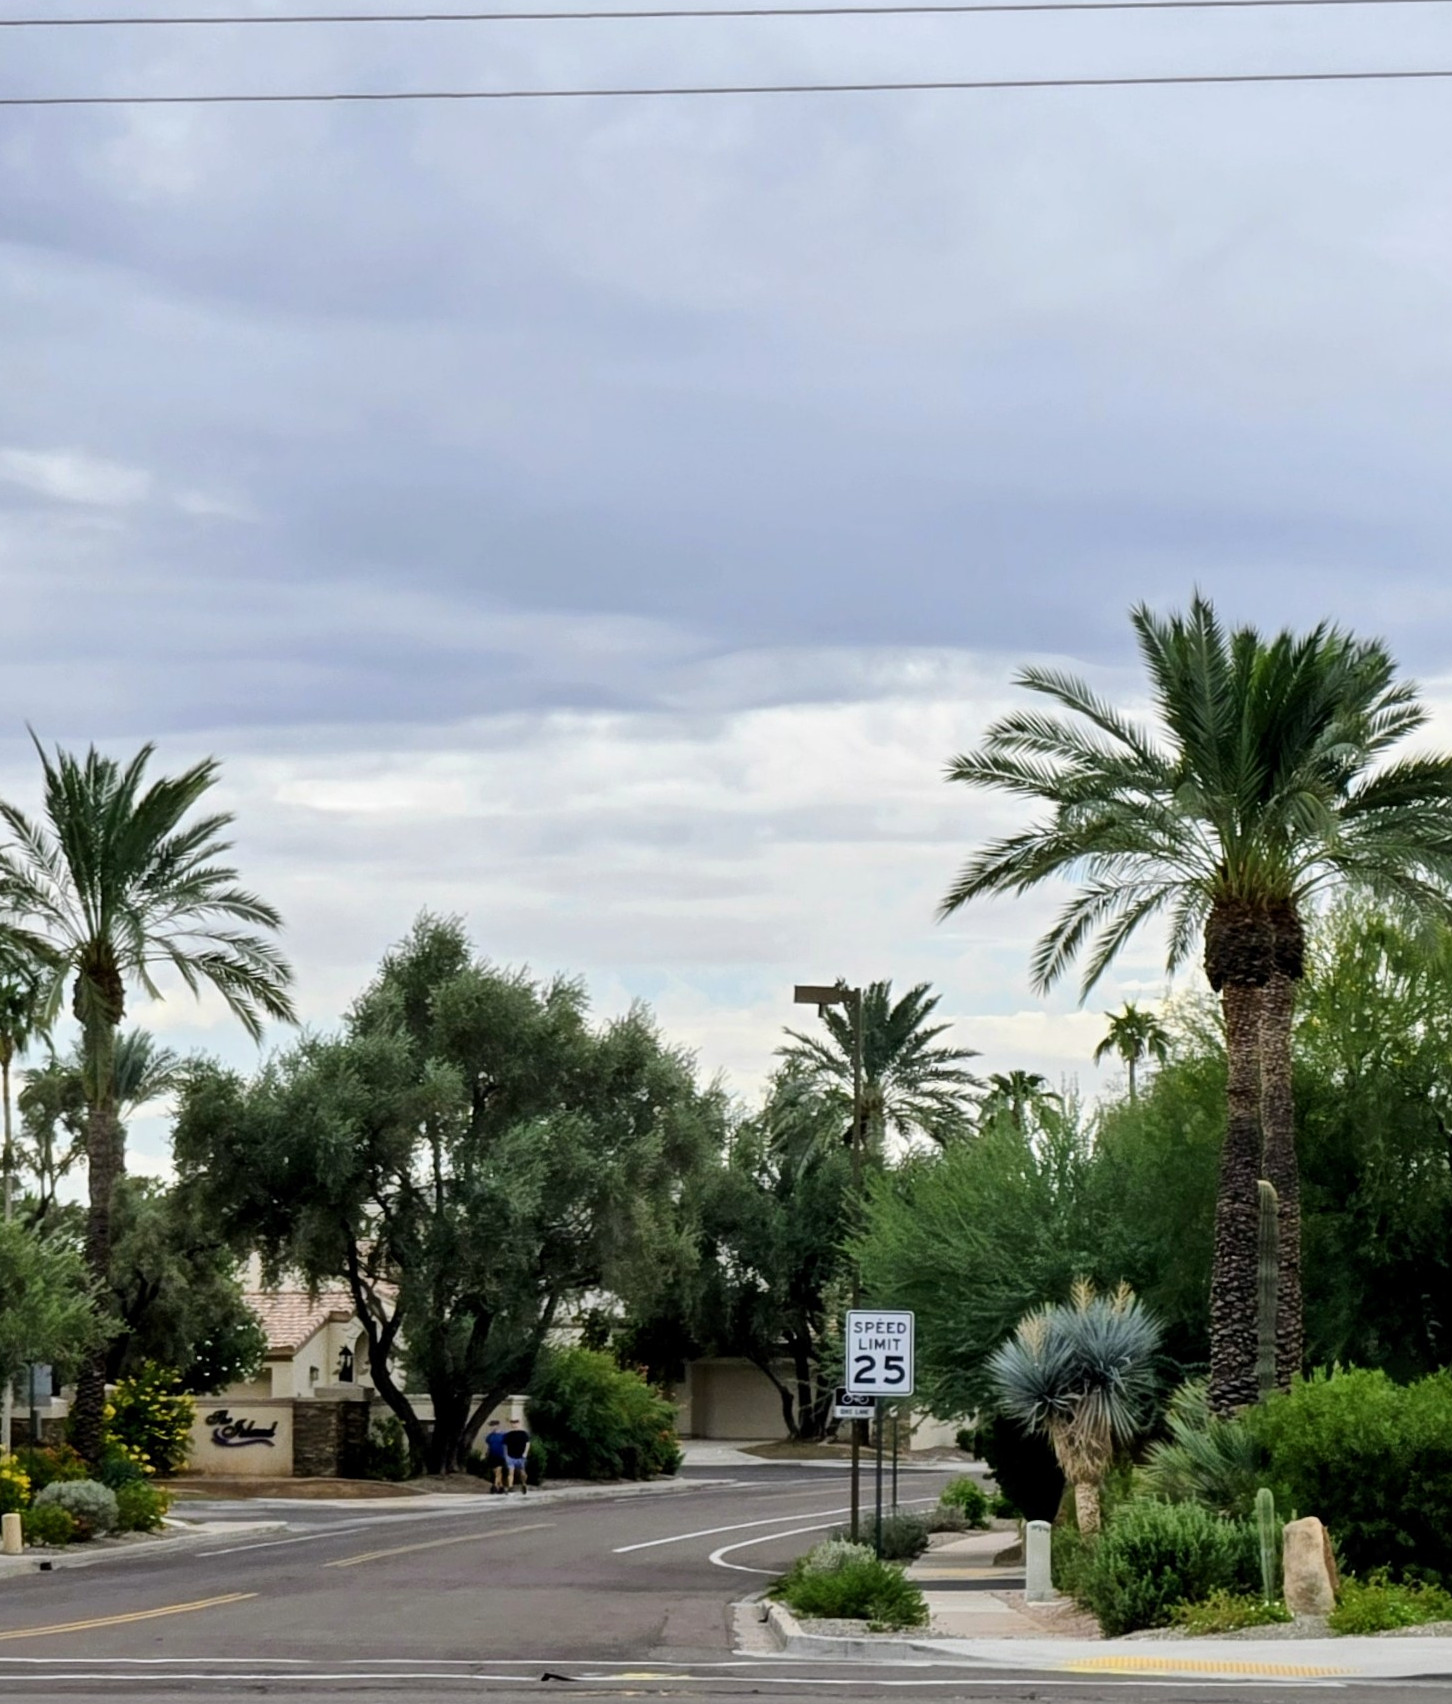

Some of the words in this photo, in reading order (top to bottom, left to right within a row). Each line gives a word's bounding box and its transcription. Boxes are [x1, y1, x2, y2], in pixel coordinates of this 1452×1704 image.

[853, 1321, 907, 1334] SPEED
[858, 1338, 902, 1351] LIMIT
[853, 1354, 906, 1385] 25
